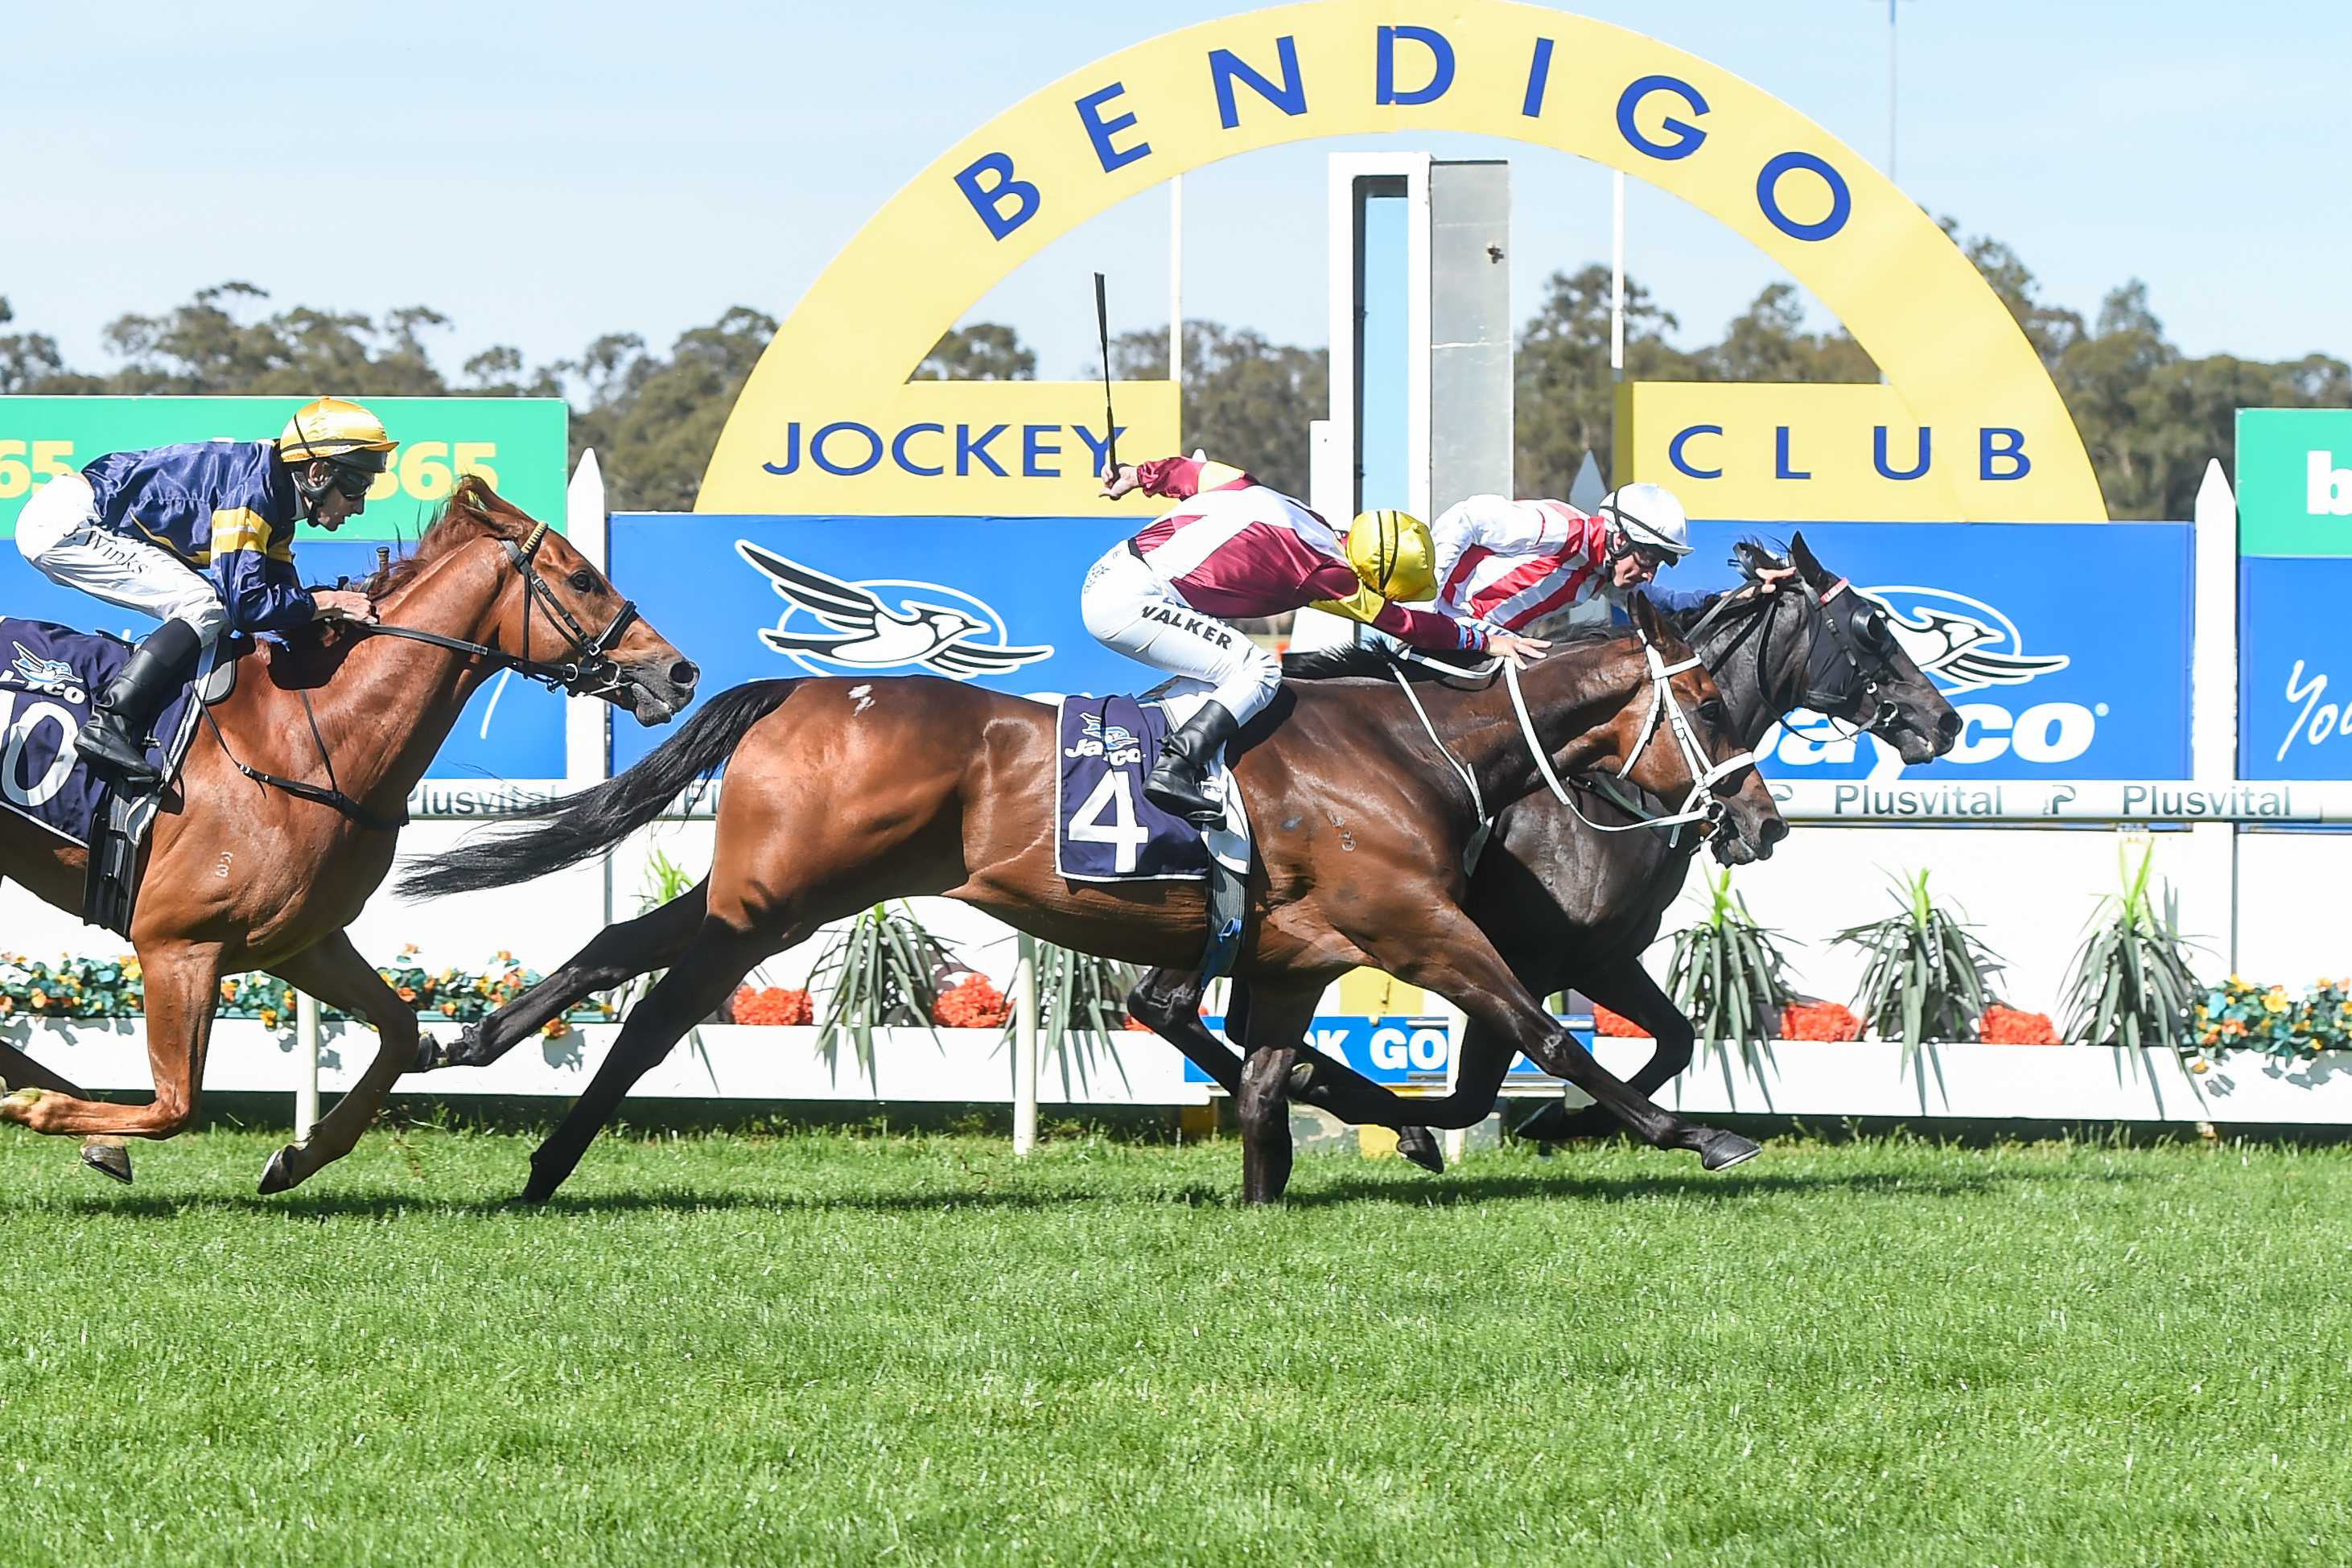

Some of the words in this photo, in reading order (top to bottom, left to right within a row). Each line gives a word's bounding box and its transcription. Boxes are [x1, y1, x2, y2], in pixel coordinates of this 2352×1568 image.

[954, 25, 1851, 241] BENDIGO
[762, 422, 1128, 478] JOCKEY
[1669, 425, 2031, 480] CLUB
[1752, 702, 2096, 779] aco
[2276, 659, 2352, 762] Yo
[1065, 738, 1142, 766] Jaco
[1068, 768, 1149, 873] 4
[1835, 784, 2003, 815] Plusvital
[2123, 785, 2291, 816] Plusvital
